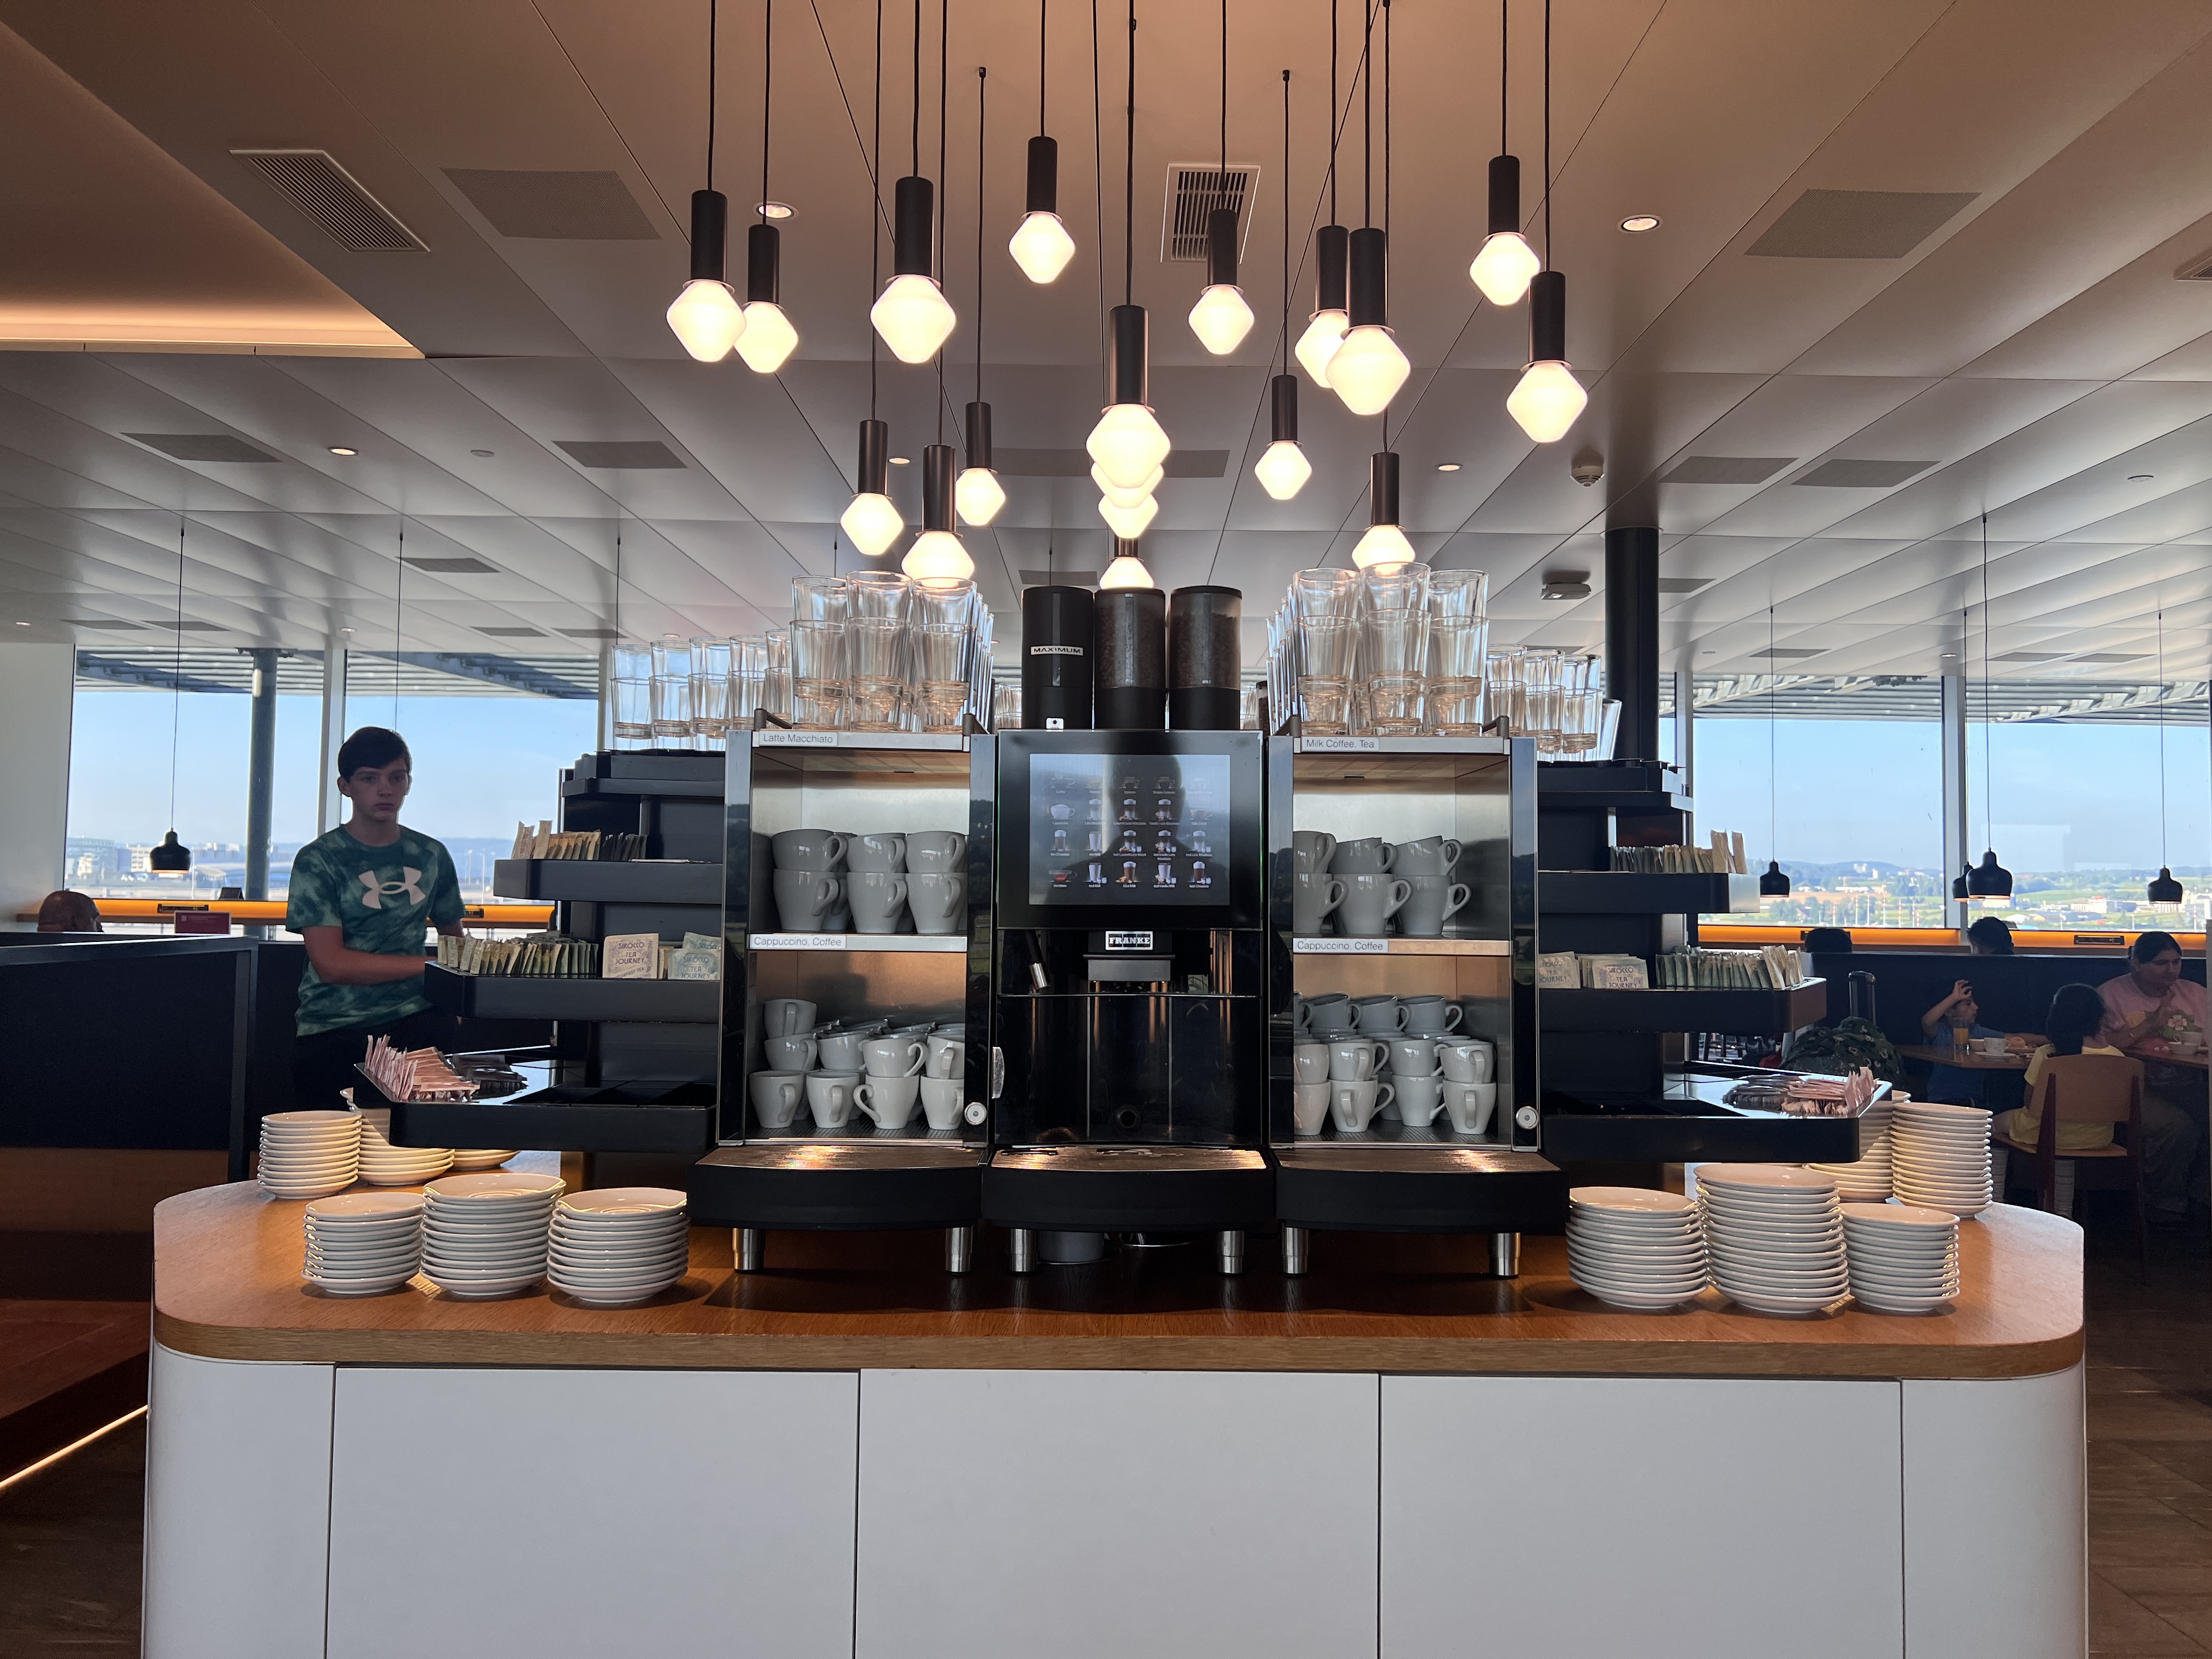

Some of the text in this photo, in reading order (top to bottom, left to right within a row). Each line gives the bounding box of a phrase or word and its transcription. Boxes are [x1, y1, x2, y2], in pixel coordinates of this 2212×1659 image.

[763, 733, 833, 743] Latte Macchiato
[1306, 739, 1375, 749] Milk Coffee, Tea
[812, 937, 842, 946] Coffee
[1355, 941, 1383, 950] Coffee
[1538, 975, 1567, 984] JOURNEY
